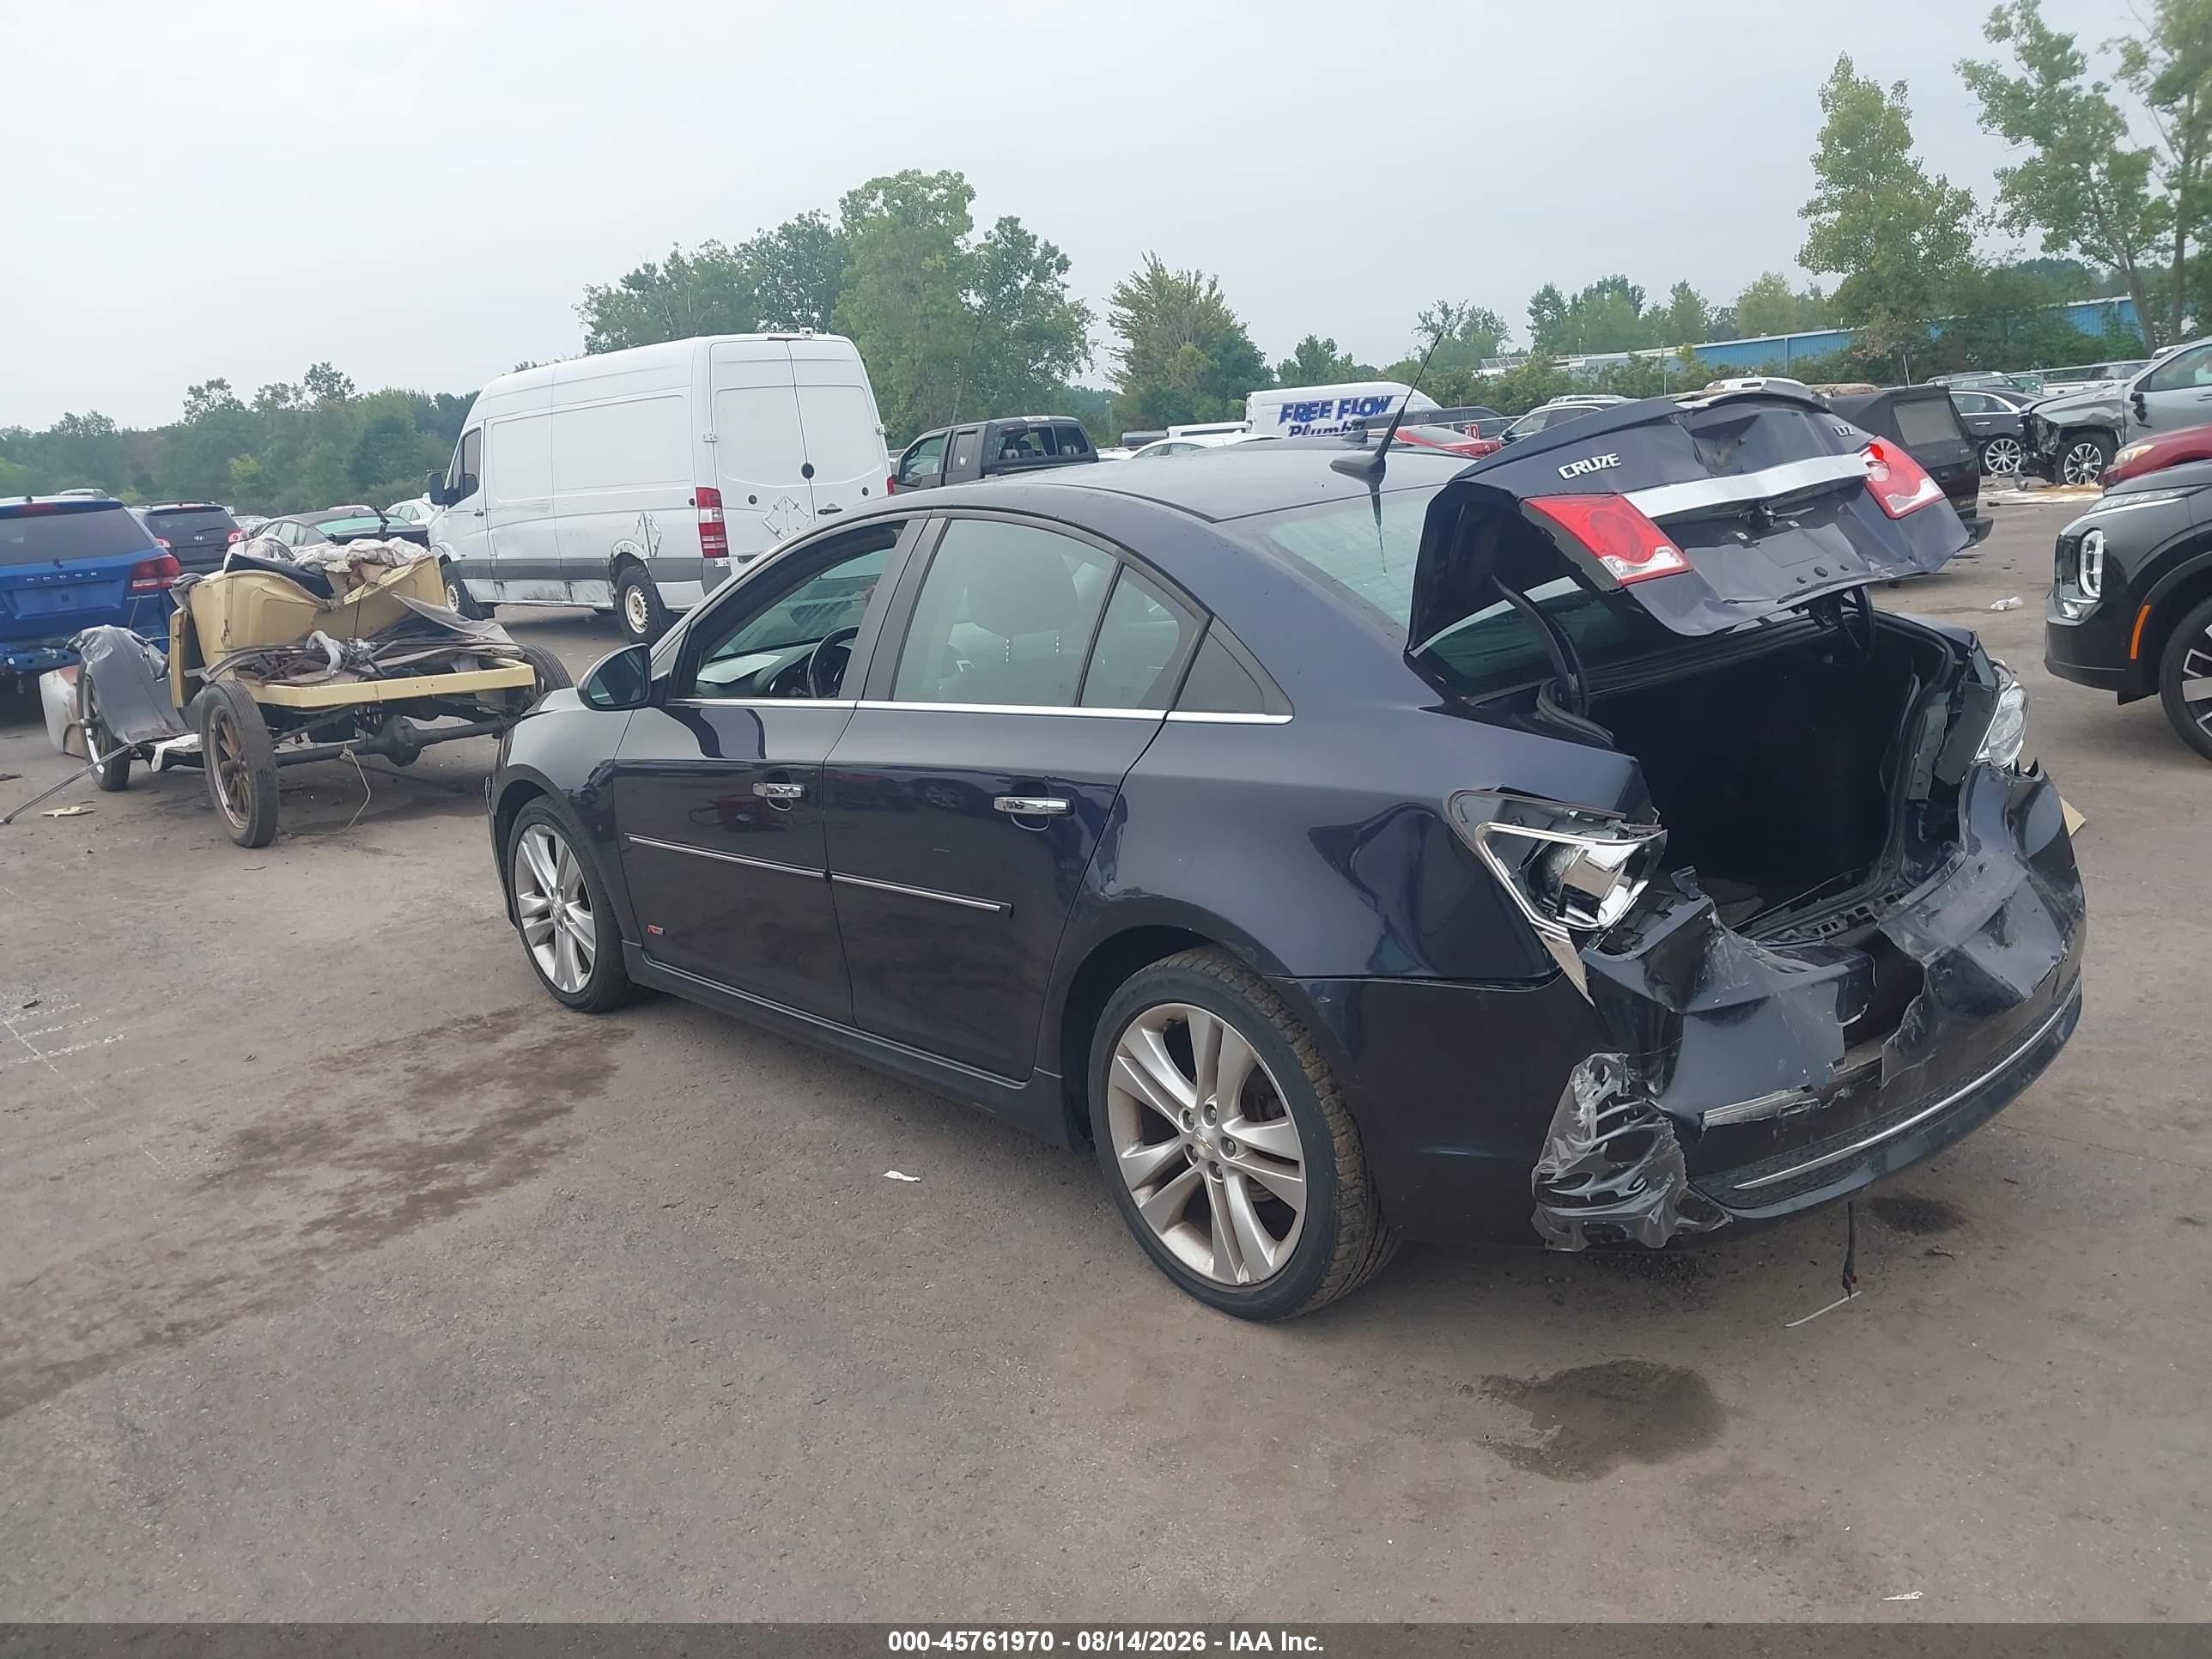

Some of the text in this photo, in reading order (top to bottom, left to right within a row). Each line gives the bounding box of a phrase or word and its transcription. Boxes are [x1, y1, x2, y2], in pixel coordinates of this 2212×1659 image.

[1279, 395, 1395, 426] FREE FLOW
[1558, 453, 1622, 479] CRUZE
